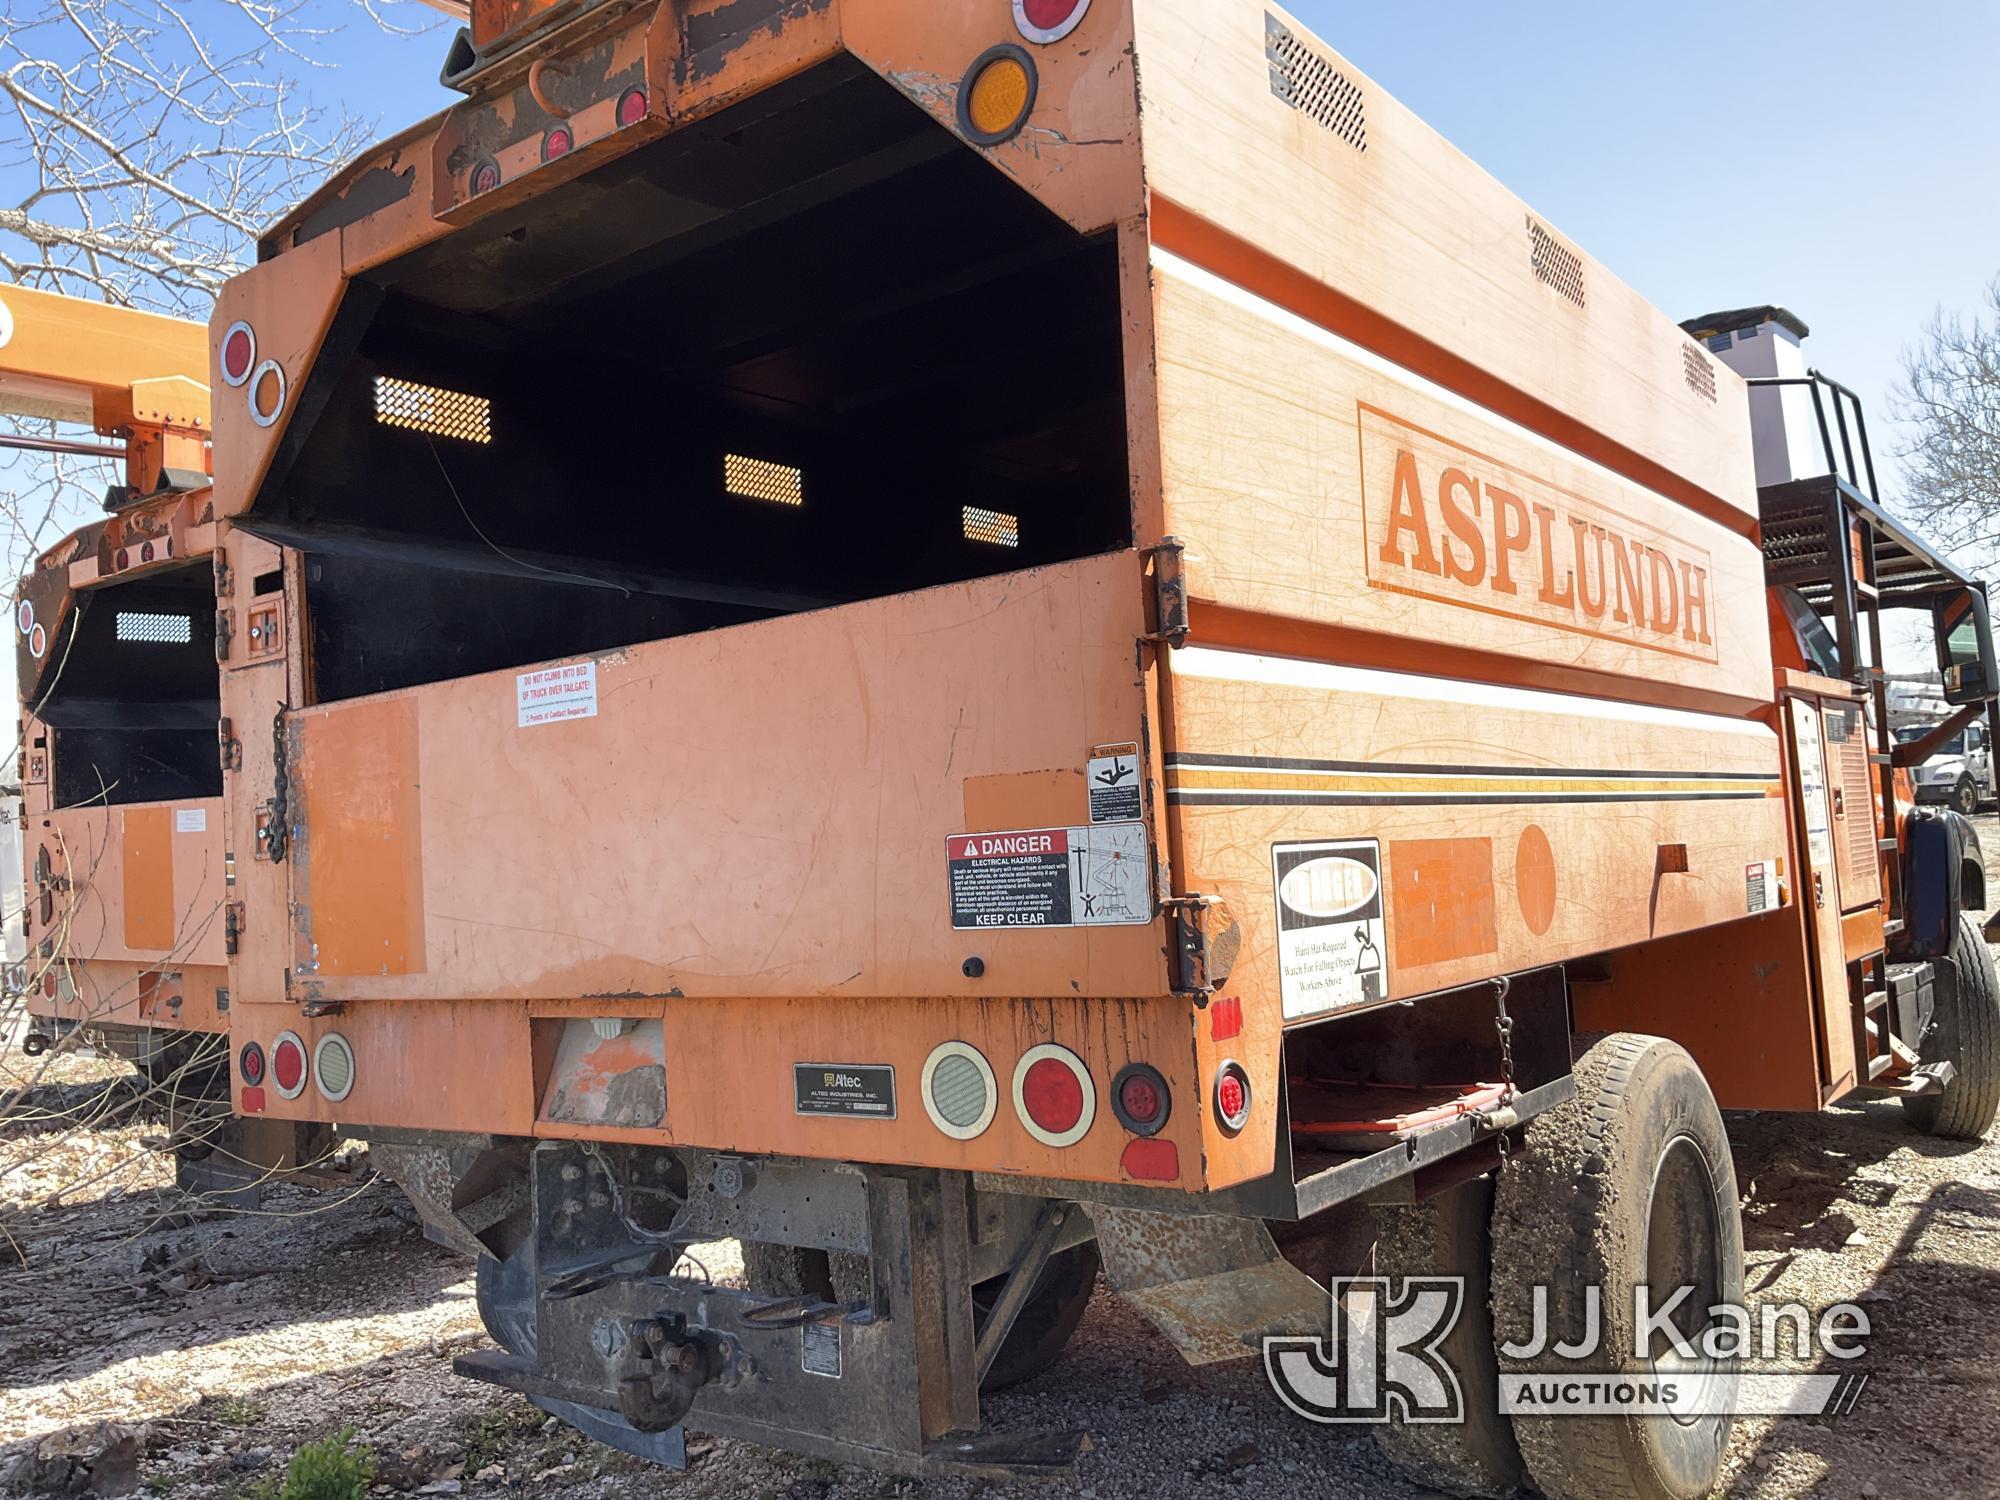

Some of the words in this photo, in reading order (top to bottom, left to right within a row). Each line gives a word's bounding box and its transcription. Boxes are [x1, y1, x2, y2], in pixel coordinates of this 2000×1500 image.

[1379, 447, 1712, 646] ASPLUNDH
[524, 676, 532, 686] DO
[533, 674, 543, 684] NOT
[544, 671, 561, 682] CLIMB
[563, 668, 575, 678] INTO
[576, 666, 588, 676] BED
[522, 691, 530, 700] OF
[531, 688, 547, 699] TRUCK
[549, 684, 562, 696] OVER
[982, 836, 1052, 855] DANGER
[971, 858, 1009, 867] ELECTRICAL
[1011, 856, 1042, 864] HAZARDS
[976, 914, 1004, 926] KEEP
[1007, 913, 1044, 924] CLEAR
[1322, 940, 1346, 956] Required
[1284, 966, 1303, 977] Watch
[1304, 962, 1314, 974] For
[1315, 960, 1334, 974] Falling
[1335, 958, 1356, 970] Objects
[1300, 980, 1323, 992] Workers
[1324, 977, 1342, 990] Above
[836, 1074, 861, 1088] Altec
